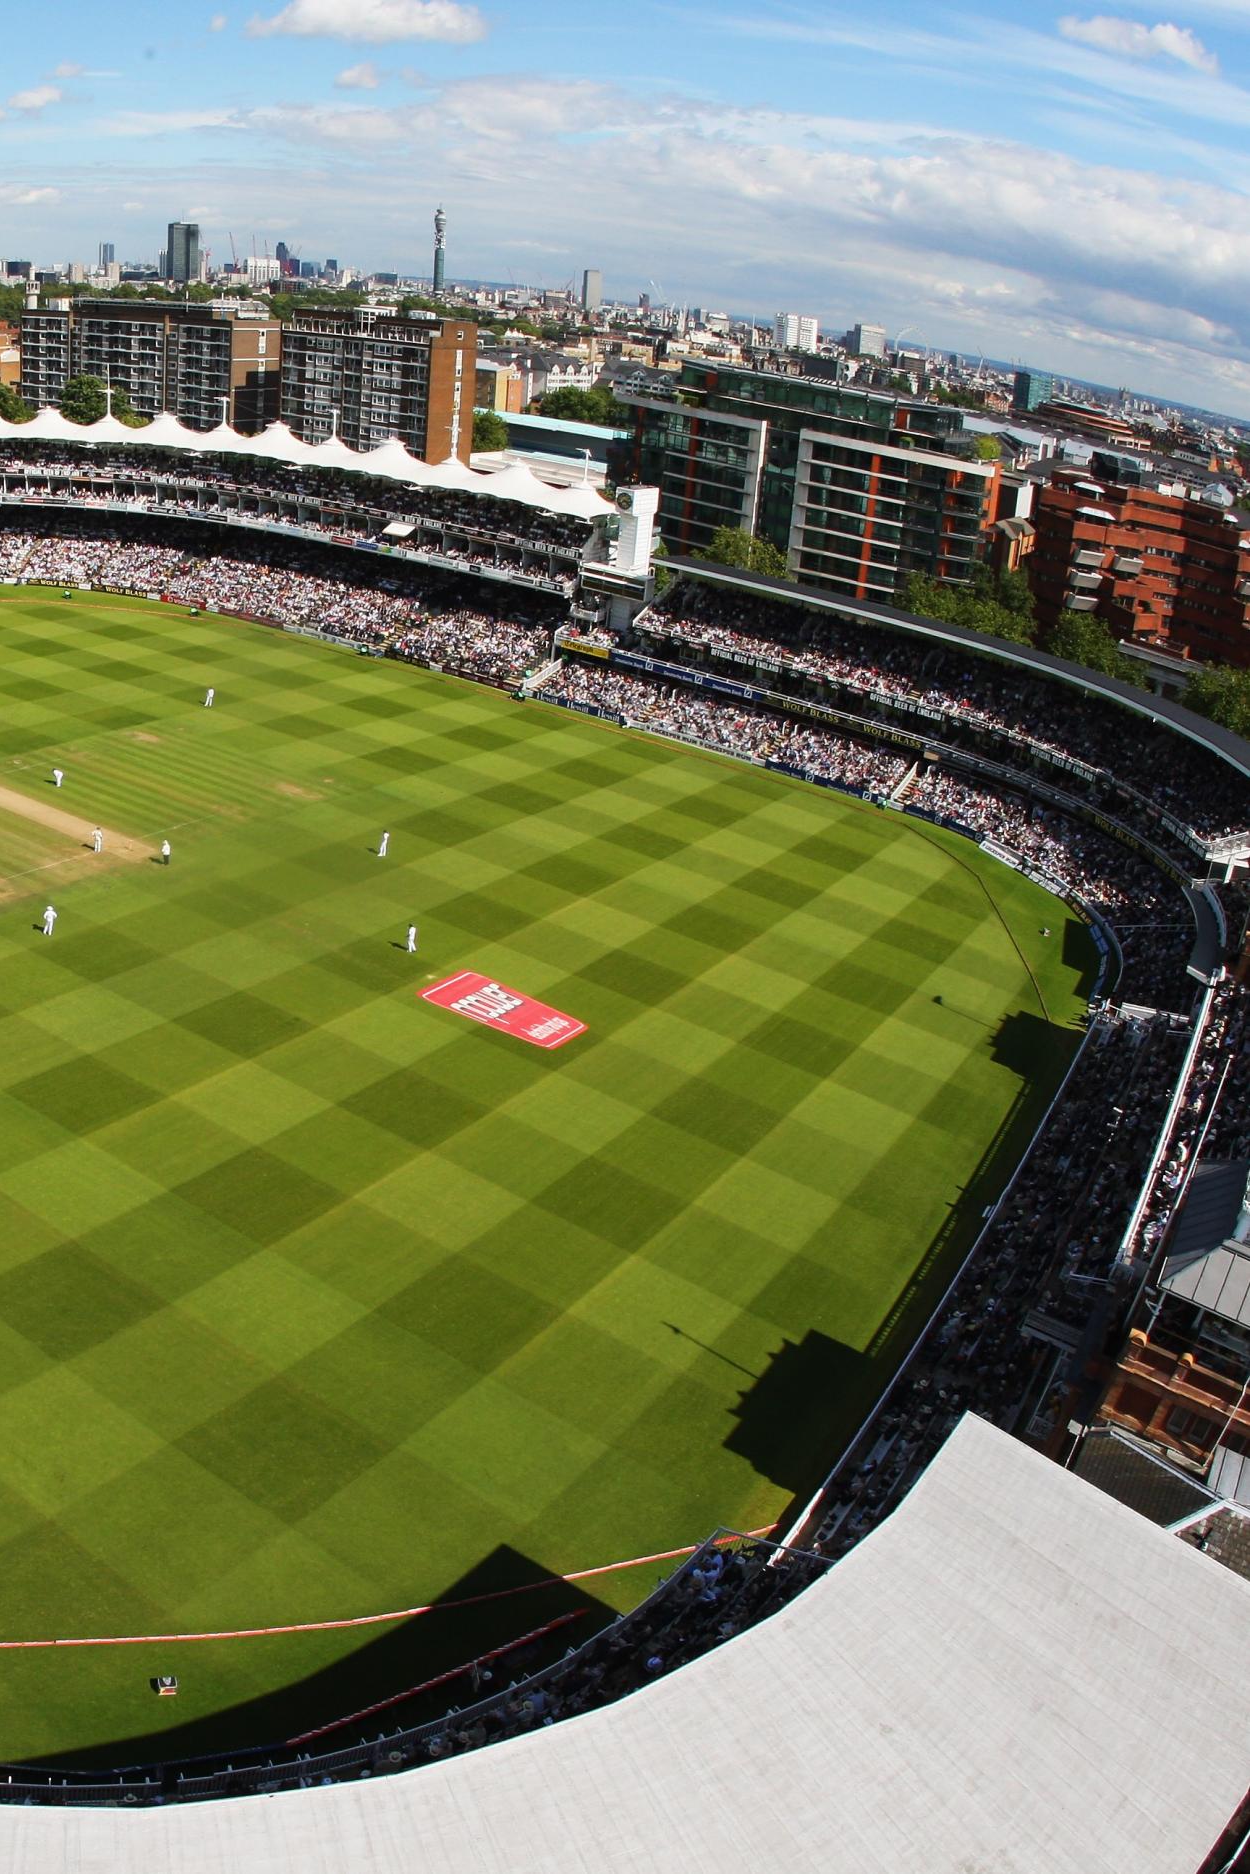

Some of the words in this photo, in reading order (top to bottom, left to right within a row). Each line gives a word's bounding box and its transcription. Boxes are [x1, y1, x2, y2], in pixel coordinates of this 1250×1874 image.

[106, 586, 124, 594] WOLF
[124, 588, 146, 598] BLASS
[710, 649, 733, 661] OFFICIAL
[734, 654, 748, 665] BEER
[748, 658, 755, 666] OF
[756, 660, 779, 673] ENGLAND
[536, 692, 558, 705] Hewitt
[566, 700, 588, 714] Hewitt
[870, 692, 893, 706] OFFICIAL
[894, 700, 908, 712] BEER
[908, 704, 916, 712] OF
[916, 706, 941, 721] ENGLAND
[598, 708, 620, 722] Hewitt
[782, 700, 807, 714] WOLF
[810, 708, 840, 724] BLASS
[651, 728, 680, 740] COCKSPUR
[682, 736, 698, 745] RUM
[863, 724, 888, 738] WOLF
[891, 732, 922, 748] BLASS
[704, 744, 734, 756] COCKSPUR
[736, 752, 751, 762] RUM
[1031, 746, 1050, 762] OFFICIAL
[1052, 755, 1066, 768] BEER
[1066, 762, 1072, 770] OF
[1072, 764, 1094, 782] ENGLAND
[1094, 814, 1114, 833] WOLF
[1116, 828, 1139, 849] BLASS
[449, 983, 524, 1025] npower
